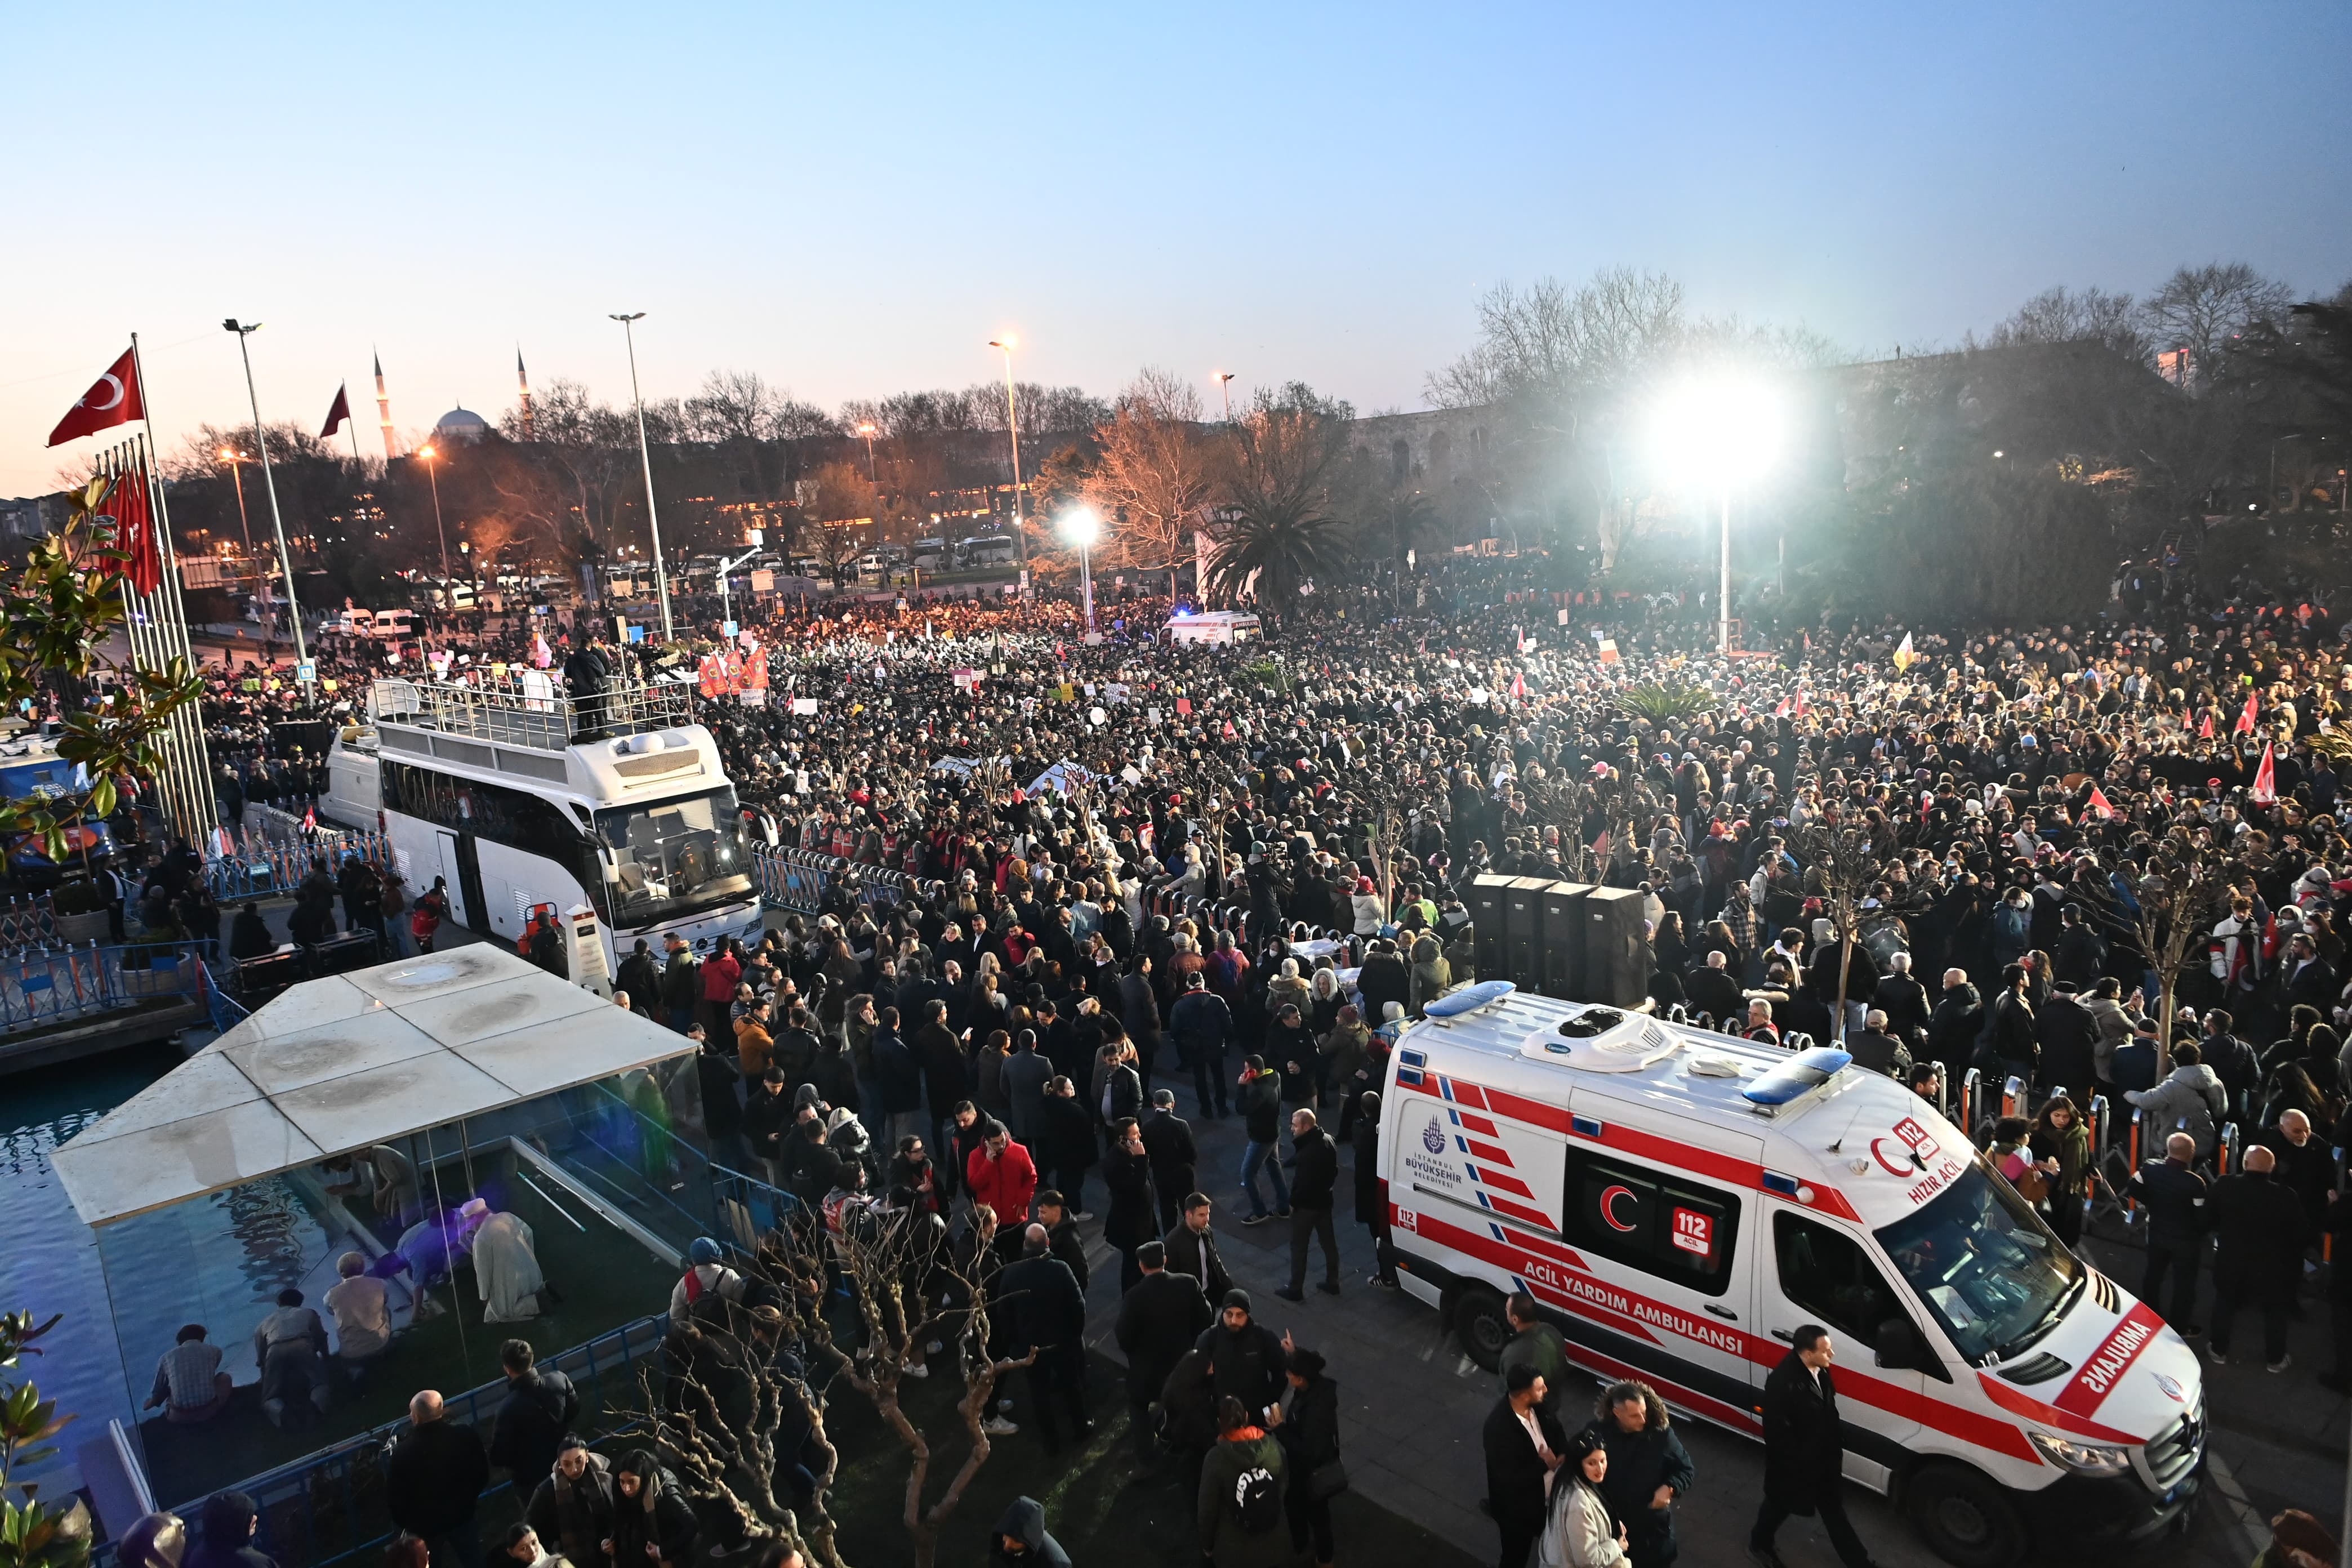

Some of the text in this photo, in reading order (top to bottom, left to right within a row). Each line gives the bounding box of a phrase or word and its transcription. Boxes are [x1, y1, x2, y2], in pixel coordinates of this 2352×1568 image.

[1898, 1122, 1925, 1144] 112
[1406, 1157, 1462, 1184] BÜYÜKŞEHİR
[1907, 1157, 1963, 1205] HIZIR ACİL
[1400, 1209, 1414, 1223] 112
[1678, 1212, 1706, 1239] 112
[1524, 1261, 1743, 1355] ACİL YARDIM AMBULANSI
